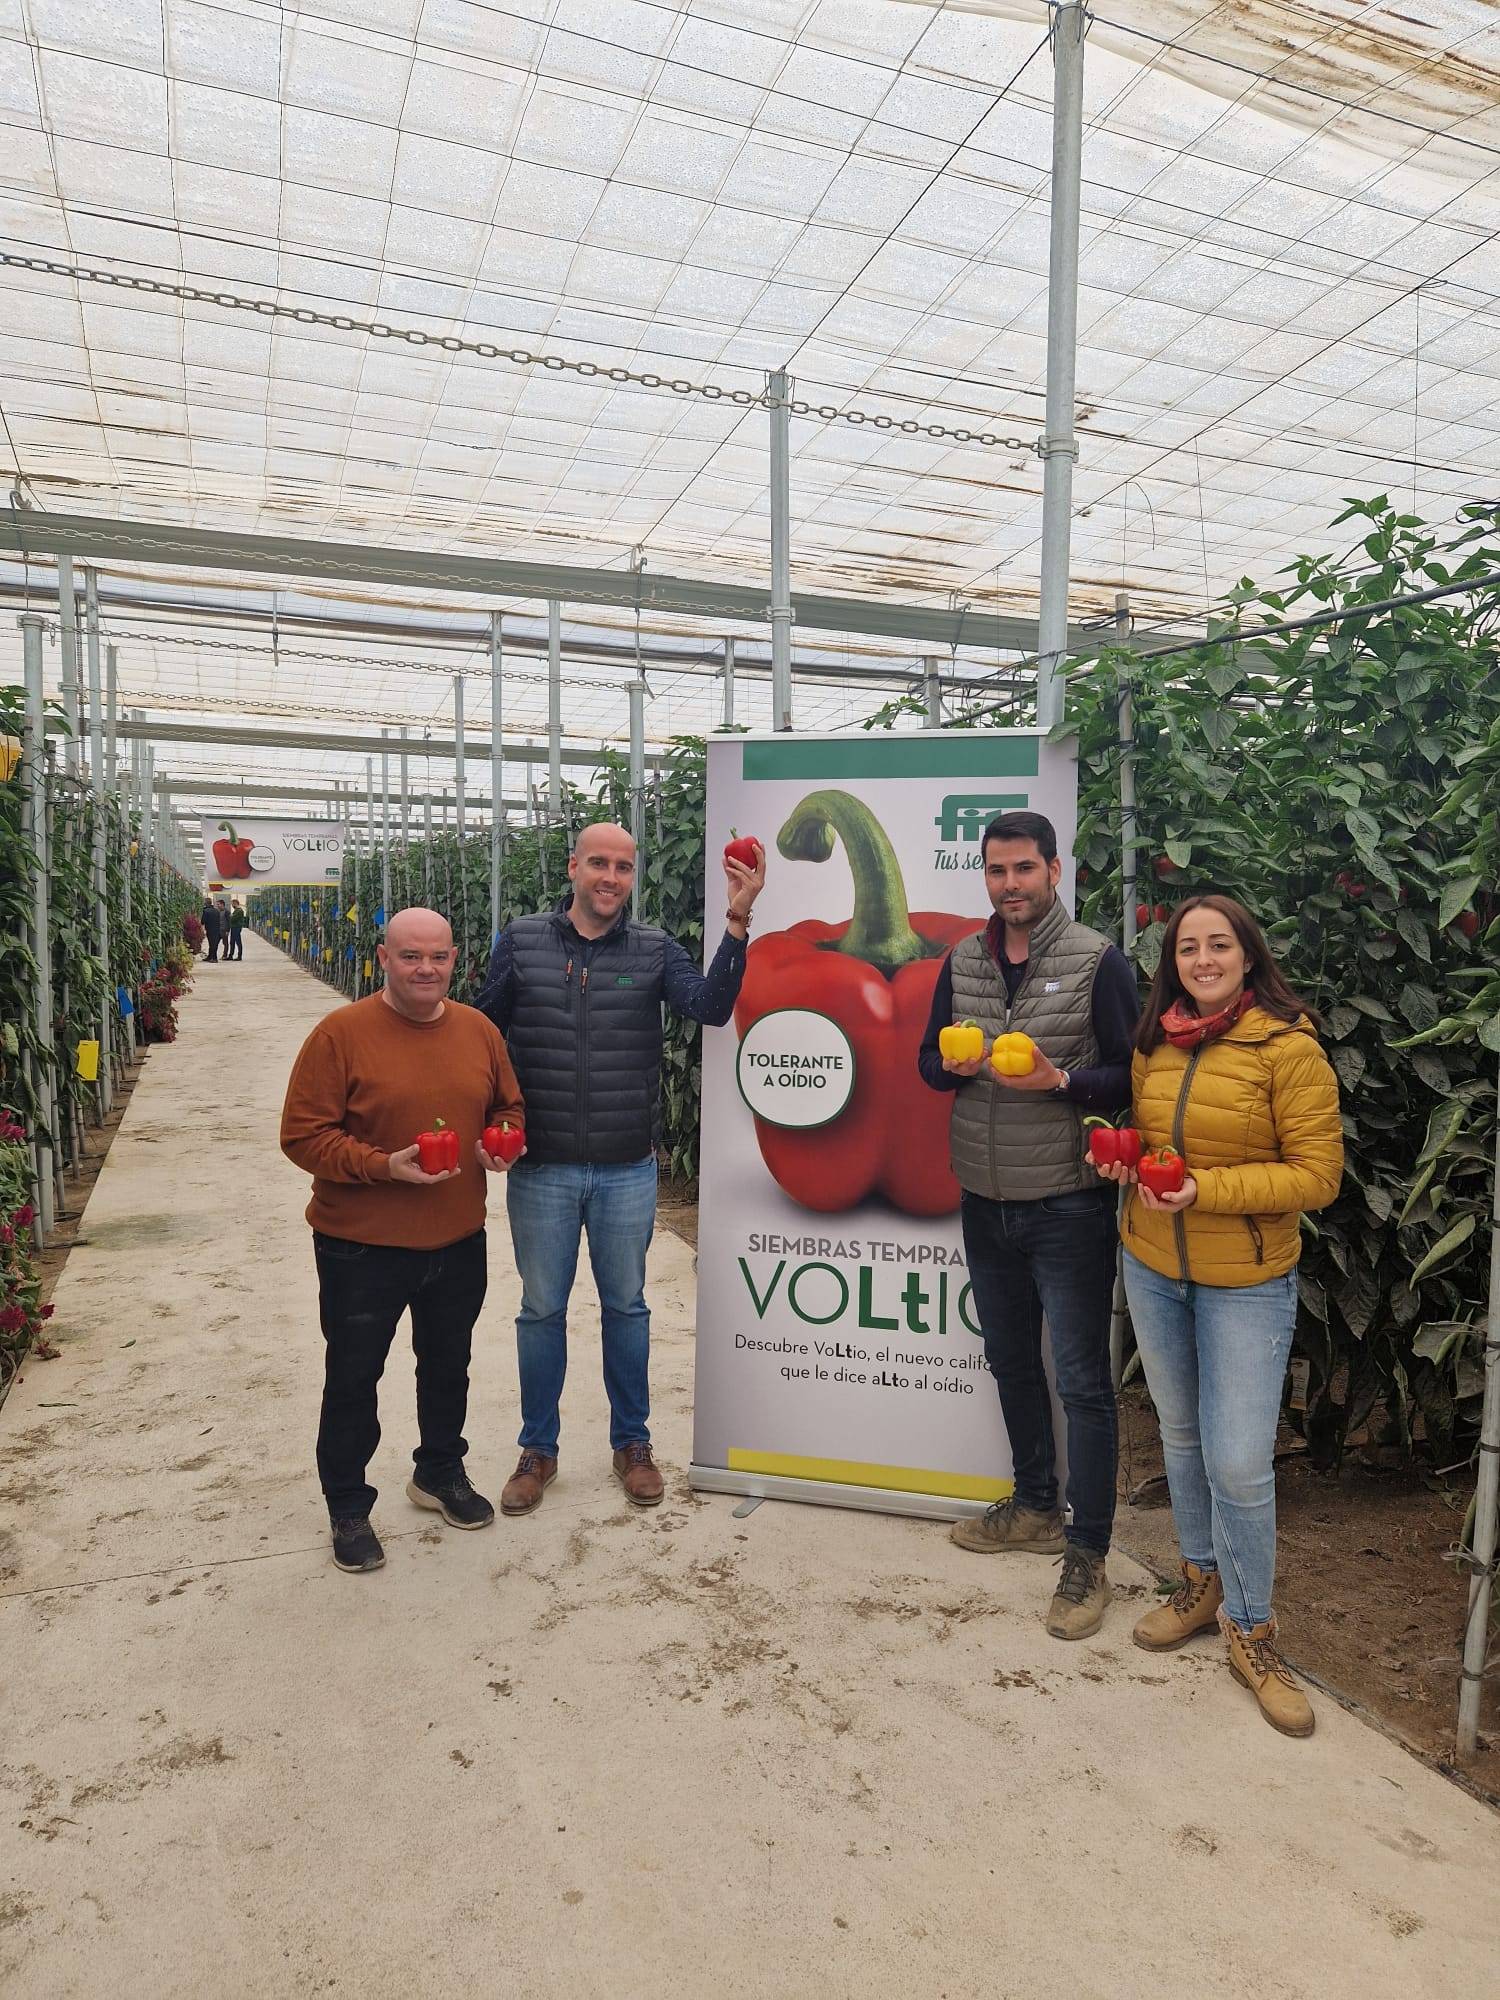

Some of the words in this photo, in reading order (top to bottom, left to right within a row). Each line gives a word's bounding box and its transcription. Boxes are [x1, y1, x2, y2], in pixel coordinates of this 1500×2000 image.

[934, 794, 1029, 842] fi
[933, 850, 959, 871] Tus
[961, 852, 985, 871] se
[747, 1053, 844, 1070] TOLERANTE
[763, 1073, 775, 1087] A
[778, 1069, 827, 1089] OÍDIO
[748, 1233, 862, 1260] SIEMBRAS
[867, 1241, 967, 1267] TEMPRA
[735, 1333, 809, 1355] Descubre
[814, 1340, 871, 1362] VoLtio,
[875, 1346, 889, 1363] el
[895, 1353, 944, 1368] nuevo
[949, 1353, 991, 1372] califo
[780, 1365, 810, 1381] que
[815, 1363, 829, 1380] le
[834, 1366, 867, 1384] dice
[872, 1371, 909, 1389] aLto
[914, 1374, 928, 1390] al
[933, 1376, 974, 1395] oídio
